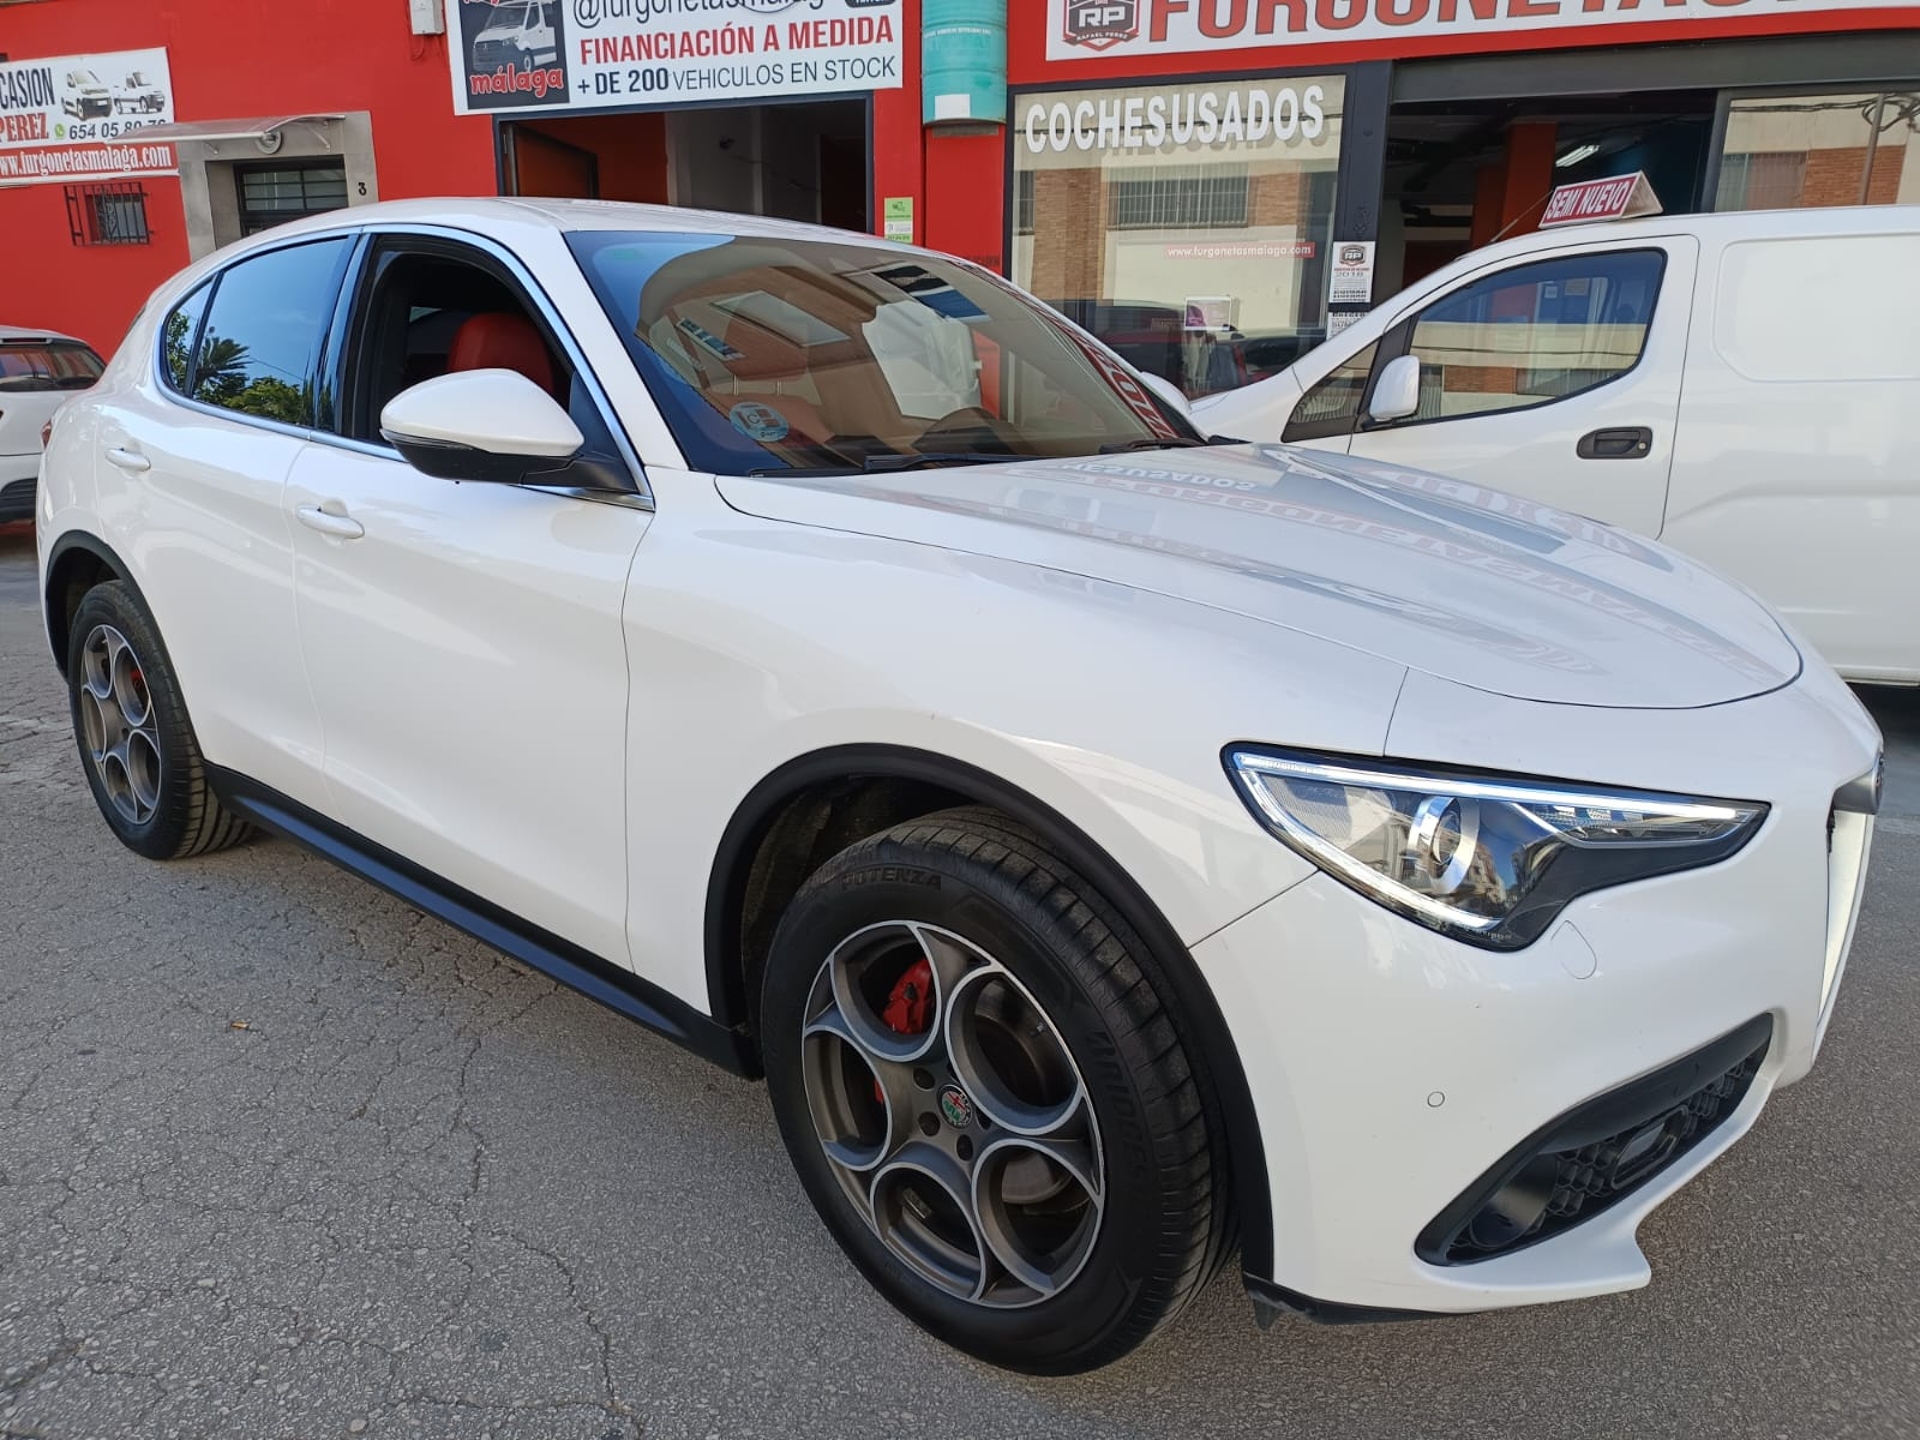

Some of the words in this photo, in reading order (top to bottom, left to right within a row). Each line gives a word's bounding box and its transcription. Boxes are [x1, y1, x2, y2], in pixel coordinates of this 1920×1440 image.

[1078, 6, 1125, 28] RP
[580, 22, 754, 65] FINANCIACIÓN
[763, 24, 780, 51] A
[788, 15, 894, 50] MEDIDA
[1076, 32, 1104, 41] RAFAEL
[469, 63, 564, 98] málaga
[595, 71, 621, 95] DE
[628, 67, 669, 92] 200
[672, 64, 784, 91] VEHICULOS
[791, 61, 817, 83] EN
[824, 55, 896, 81] STOCK
[69, 124, 97, 140] 654
[101, 122, 119, 138] 05
[358, 181, 367, 196] 3
[1546, 187, 1583, 219] SEMI
[1575, 181, 1631, 216] NUEVO
[1168, 245, 1311, 258] www.furgonetasmalaga.com
